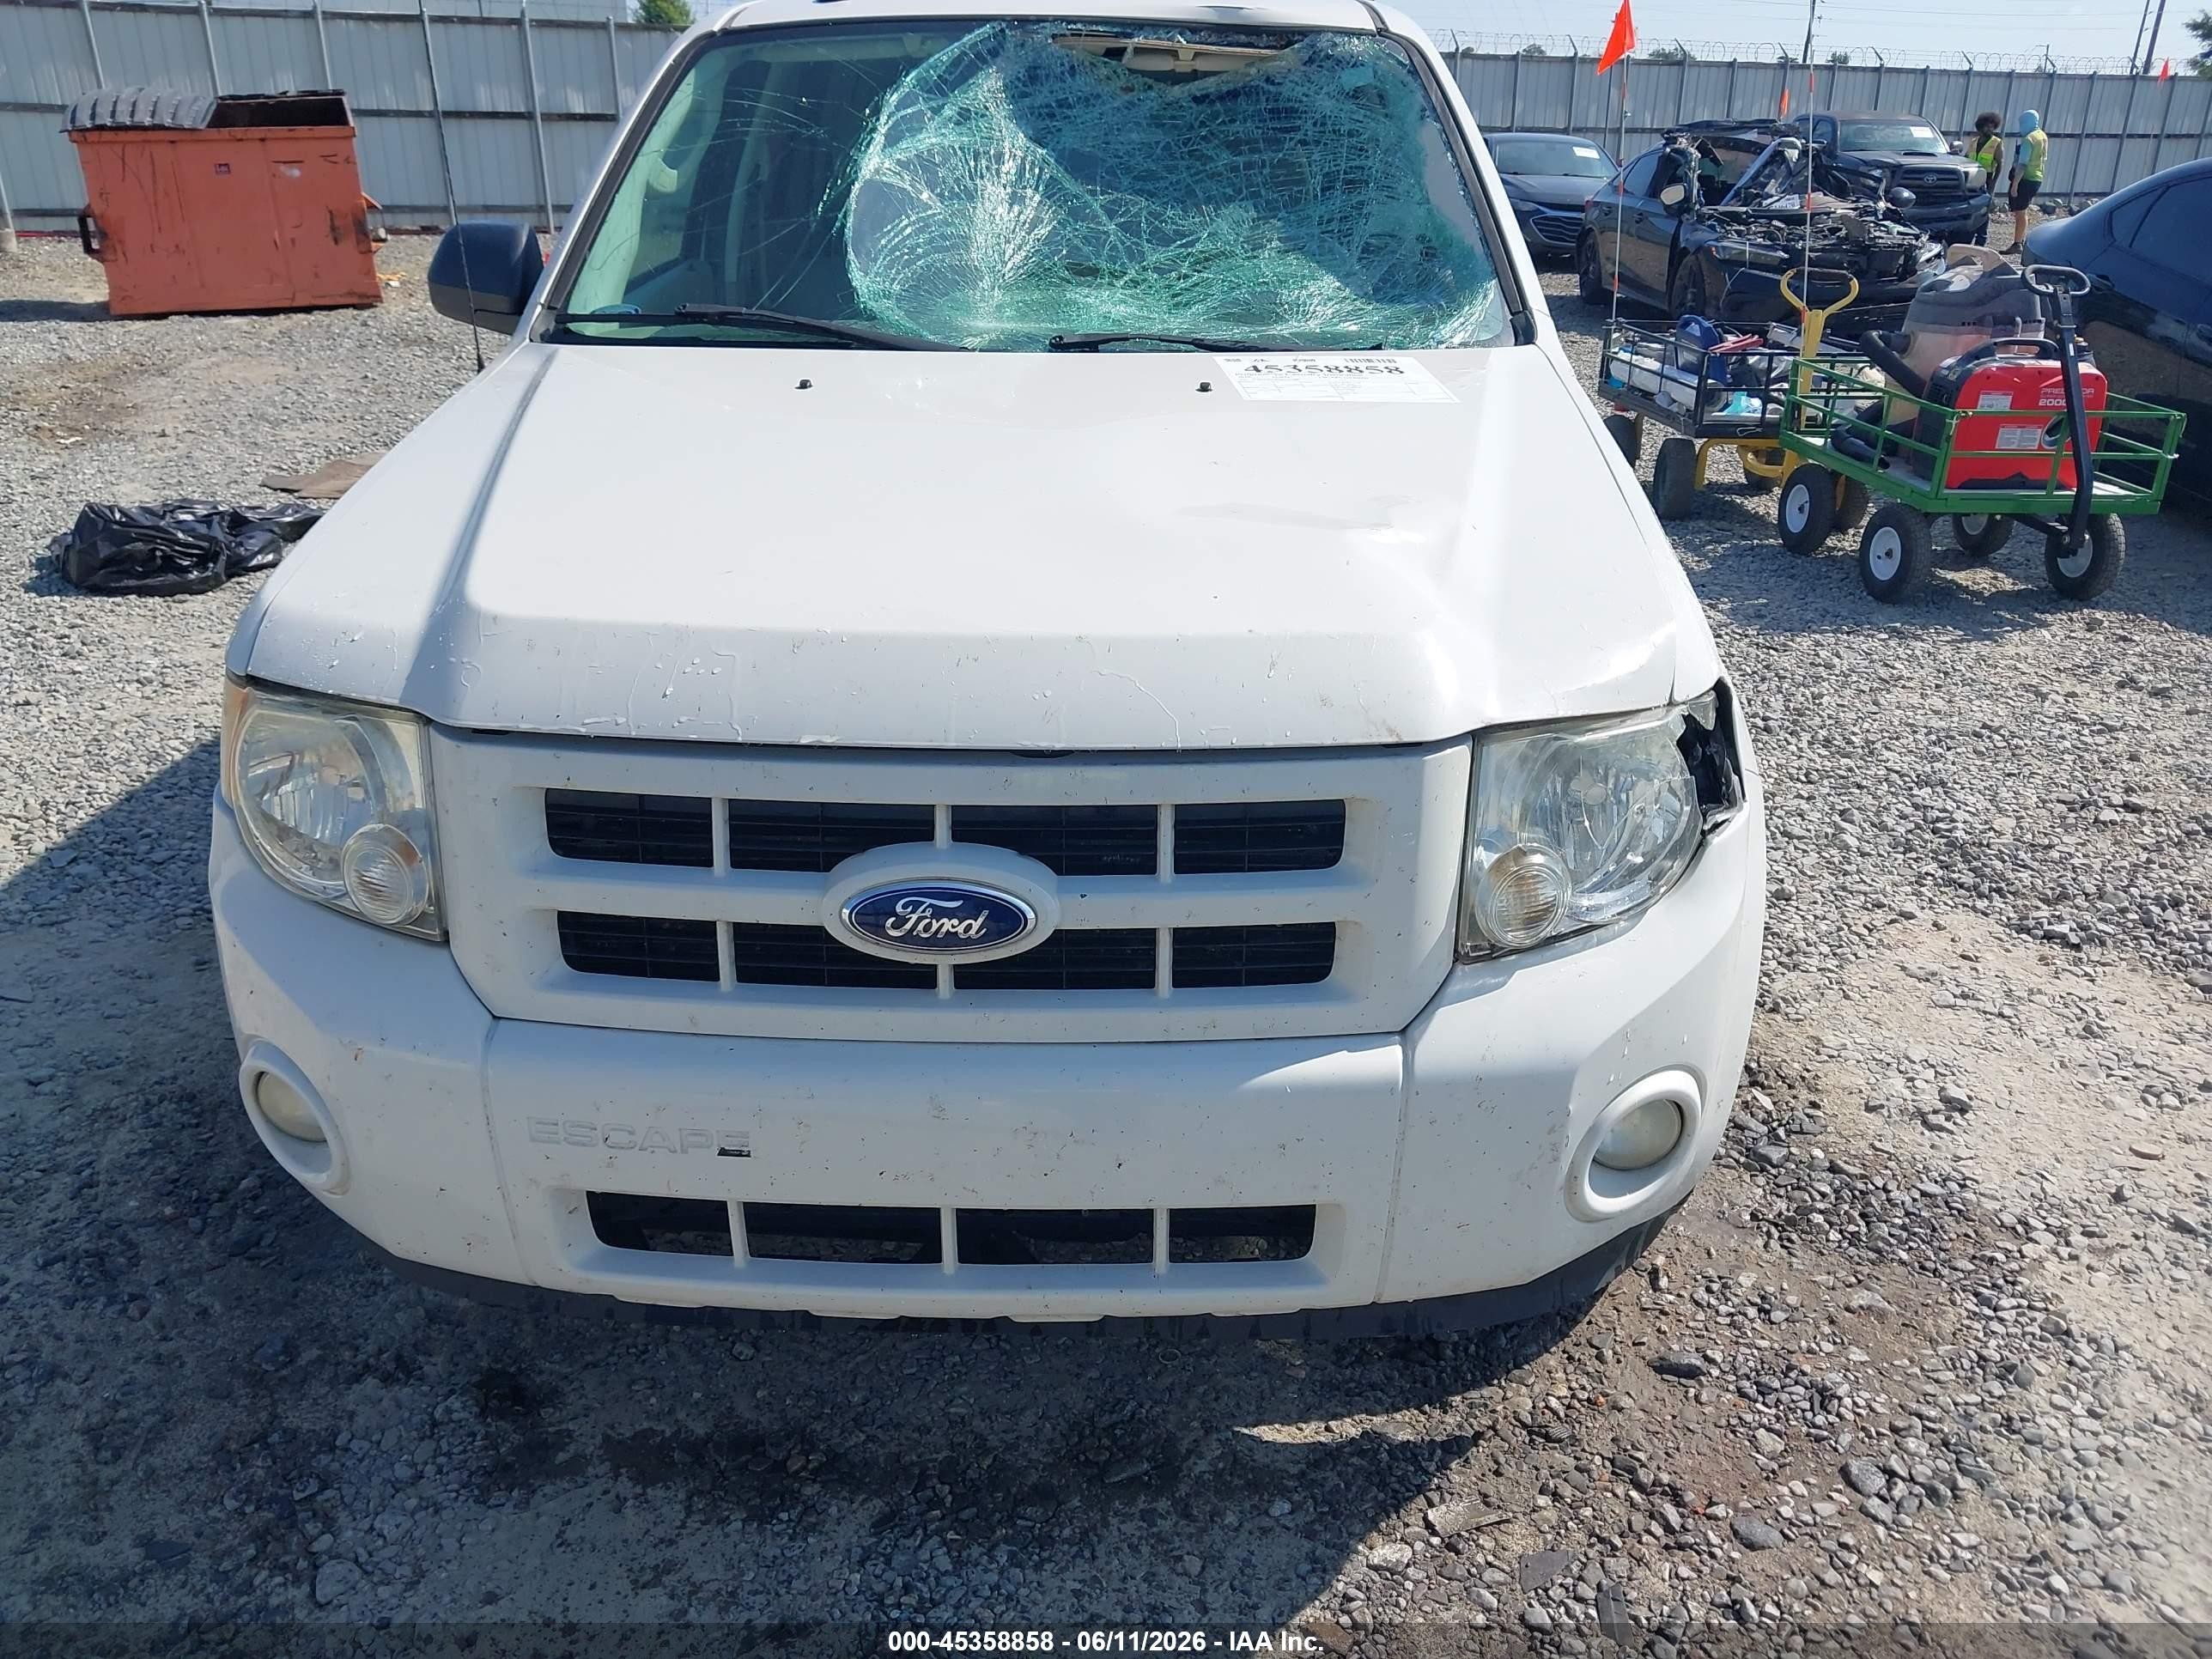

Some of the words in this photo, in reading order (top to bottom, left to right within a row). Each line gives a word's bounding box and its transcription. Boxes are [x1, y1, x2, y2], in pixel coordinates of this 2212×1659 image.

[1243, 364, 1406, 375] 45358858
[885, 896, 989, 939] Ford
[526, 1116, 750, 1154] ESCAPE
